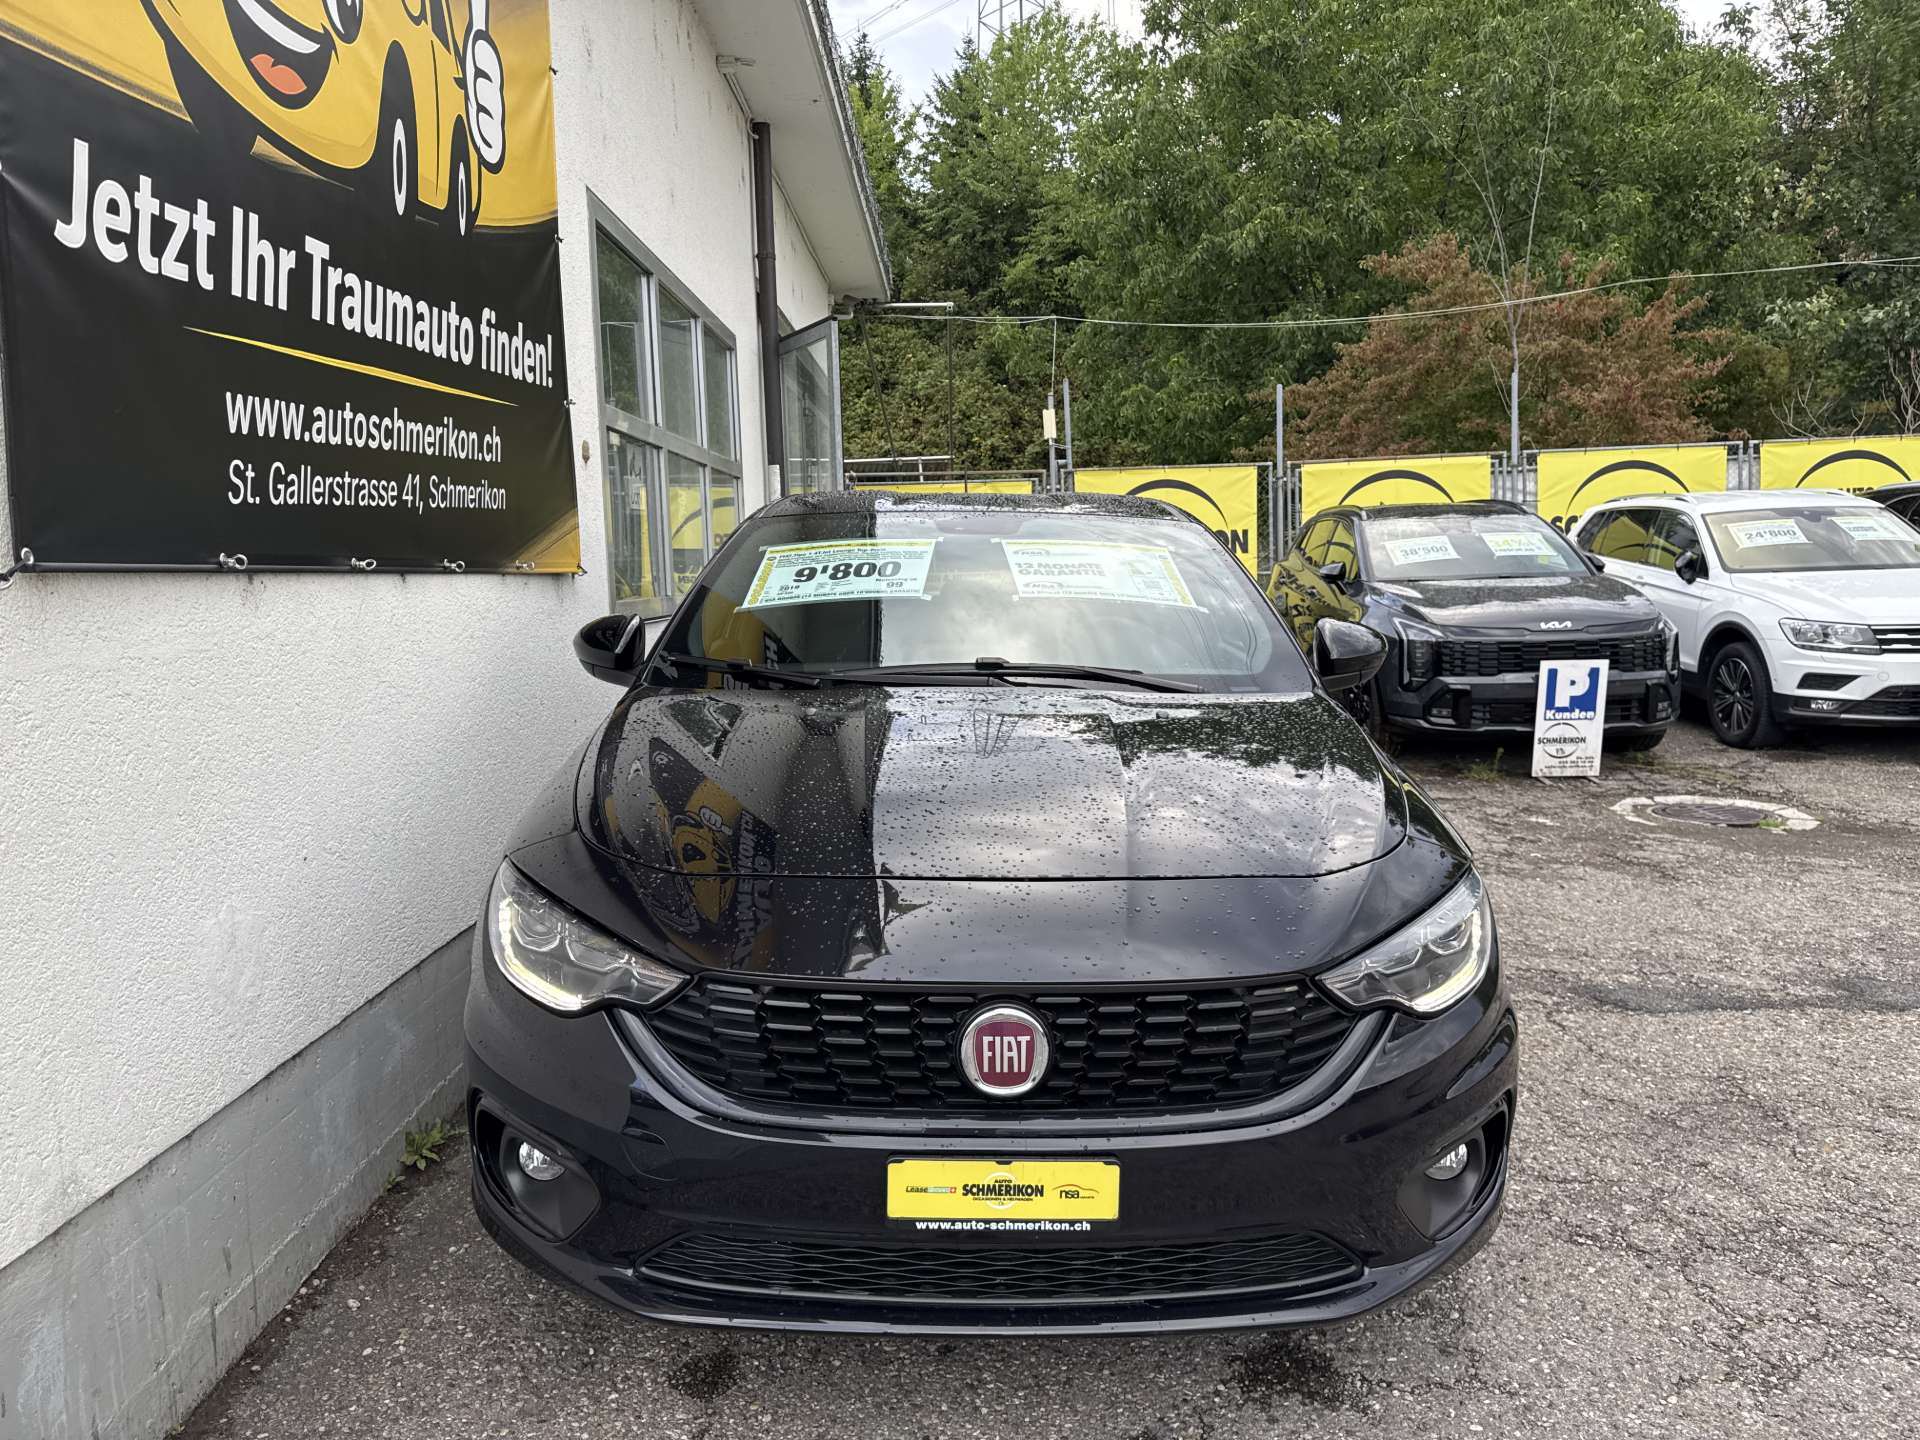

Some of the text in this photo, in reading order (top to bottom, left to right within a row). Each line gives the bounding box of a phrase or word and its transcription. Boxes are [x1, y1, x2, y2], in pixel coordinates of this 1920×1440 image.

[54, 138, 553, 389] Jetzt Ihr Traumauto finden!
[226, 392, 501, 463] www.autoschmerikon.ch
[228, 460, 506, 515] St. Gallerstrasse 41, Schmerikon
[793, 561, 902, 583] 9'800
[1037, 562, 1103, 570] MONATE
[1018, 569, 1106, 577] GARANTIE
[1545, 708, 1596, 720] Kunden
[1537, 736, 1587, 745] SCHMERIKON
[982, 1036, 1031, 1073] FIAT
[962, 1184, 1044, 1197] SCHMERIKON
[1059, 1190, 1079, 1199] nsa
[915, 1221, 1091, 1231] www.auto-schmerikon.ch
